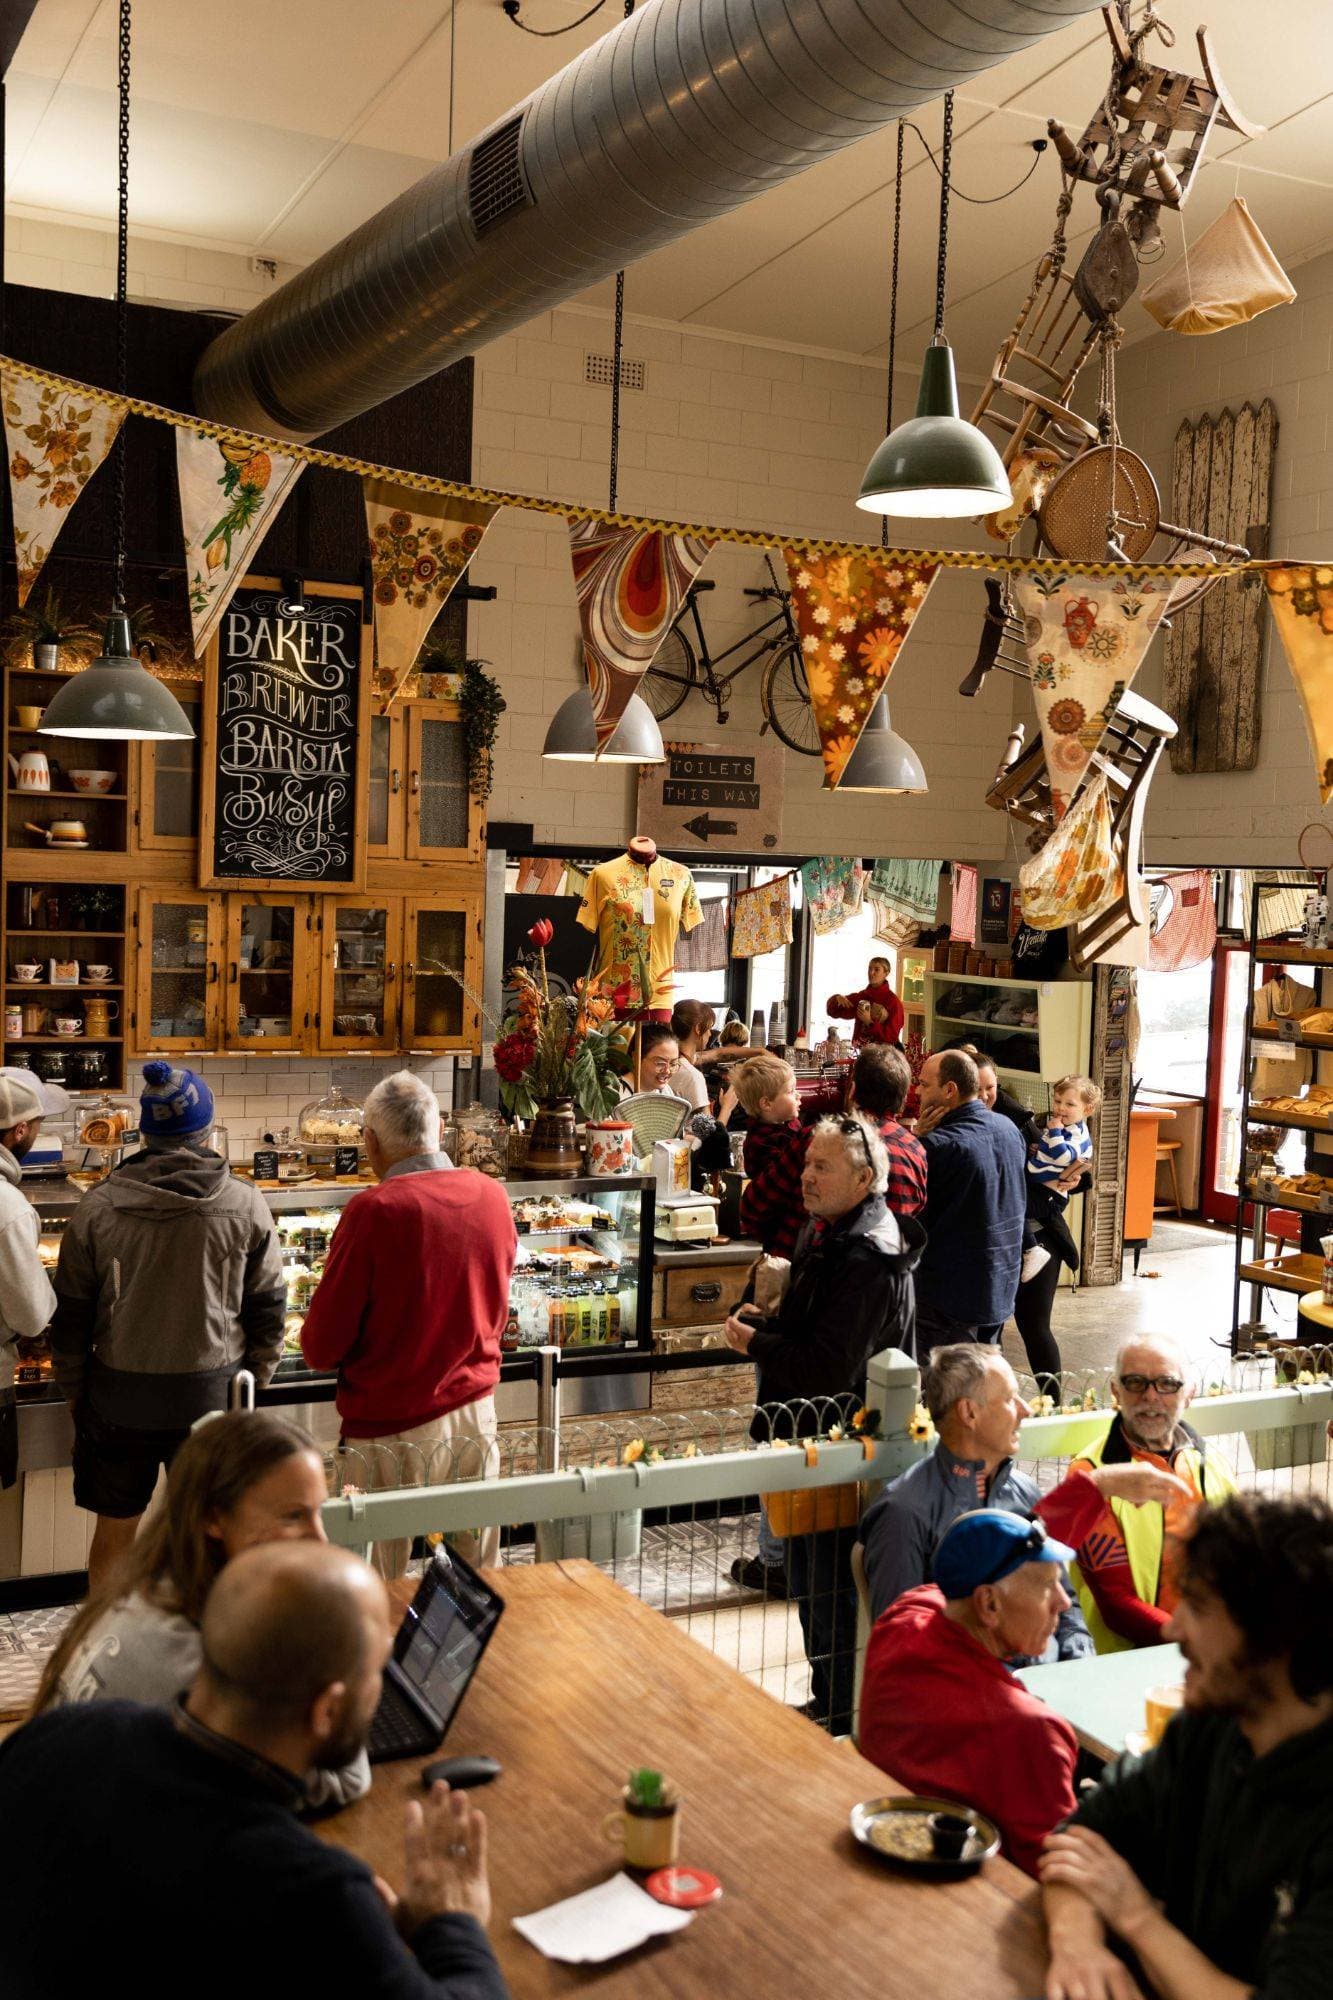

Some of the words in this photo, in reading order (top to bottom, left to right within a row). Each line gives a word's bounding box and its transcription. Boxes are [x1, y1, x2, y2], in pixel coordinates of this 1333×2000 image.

[227, 613, 356, 690] BAKER
[221, 671, 354, 732] BREWER
[220, 720, 351, 780] BARISTA
[673, 760, 752, 776] TOILETS
[665, 787, 710, 801] THIS
[724, 790, 758, 803] WAY
